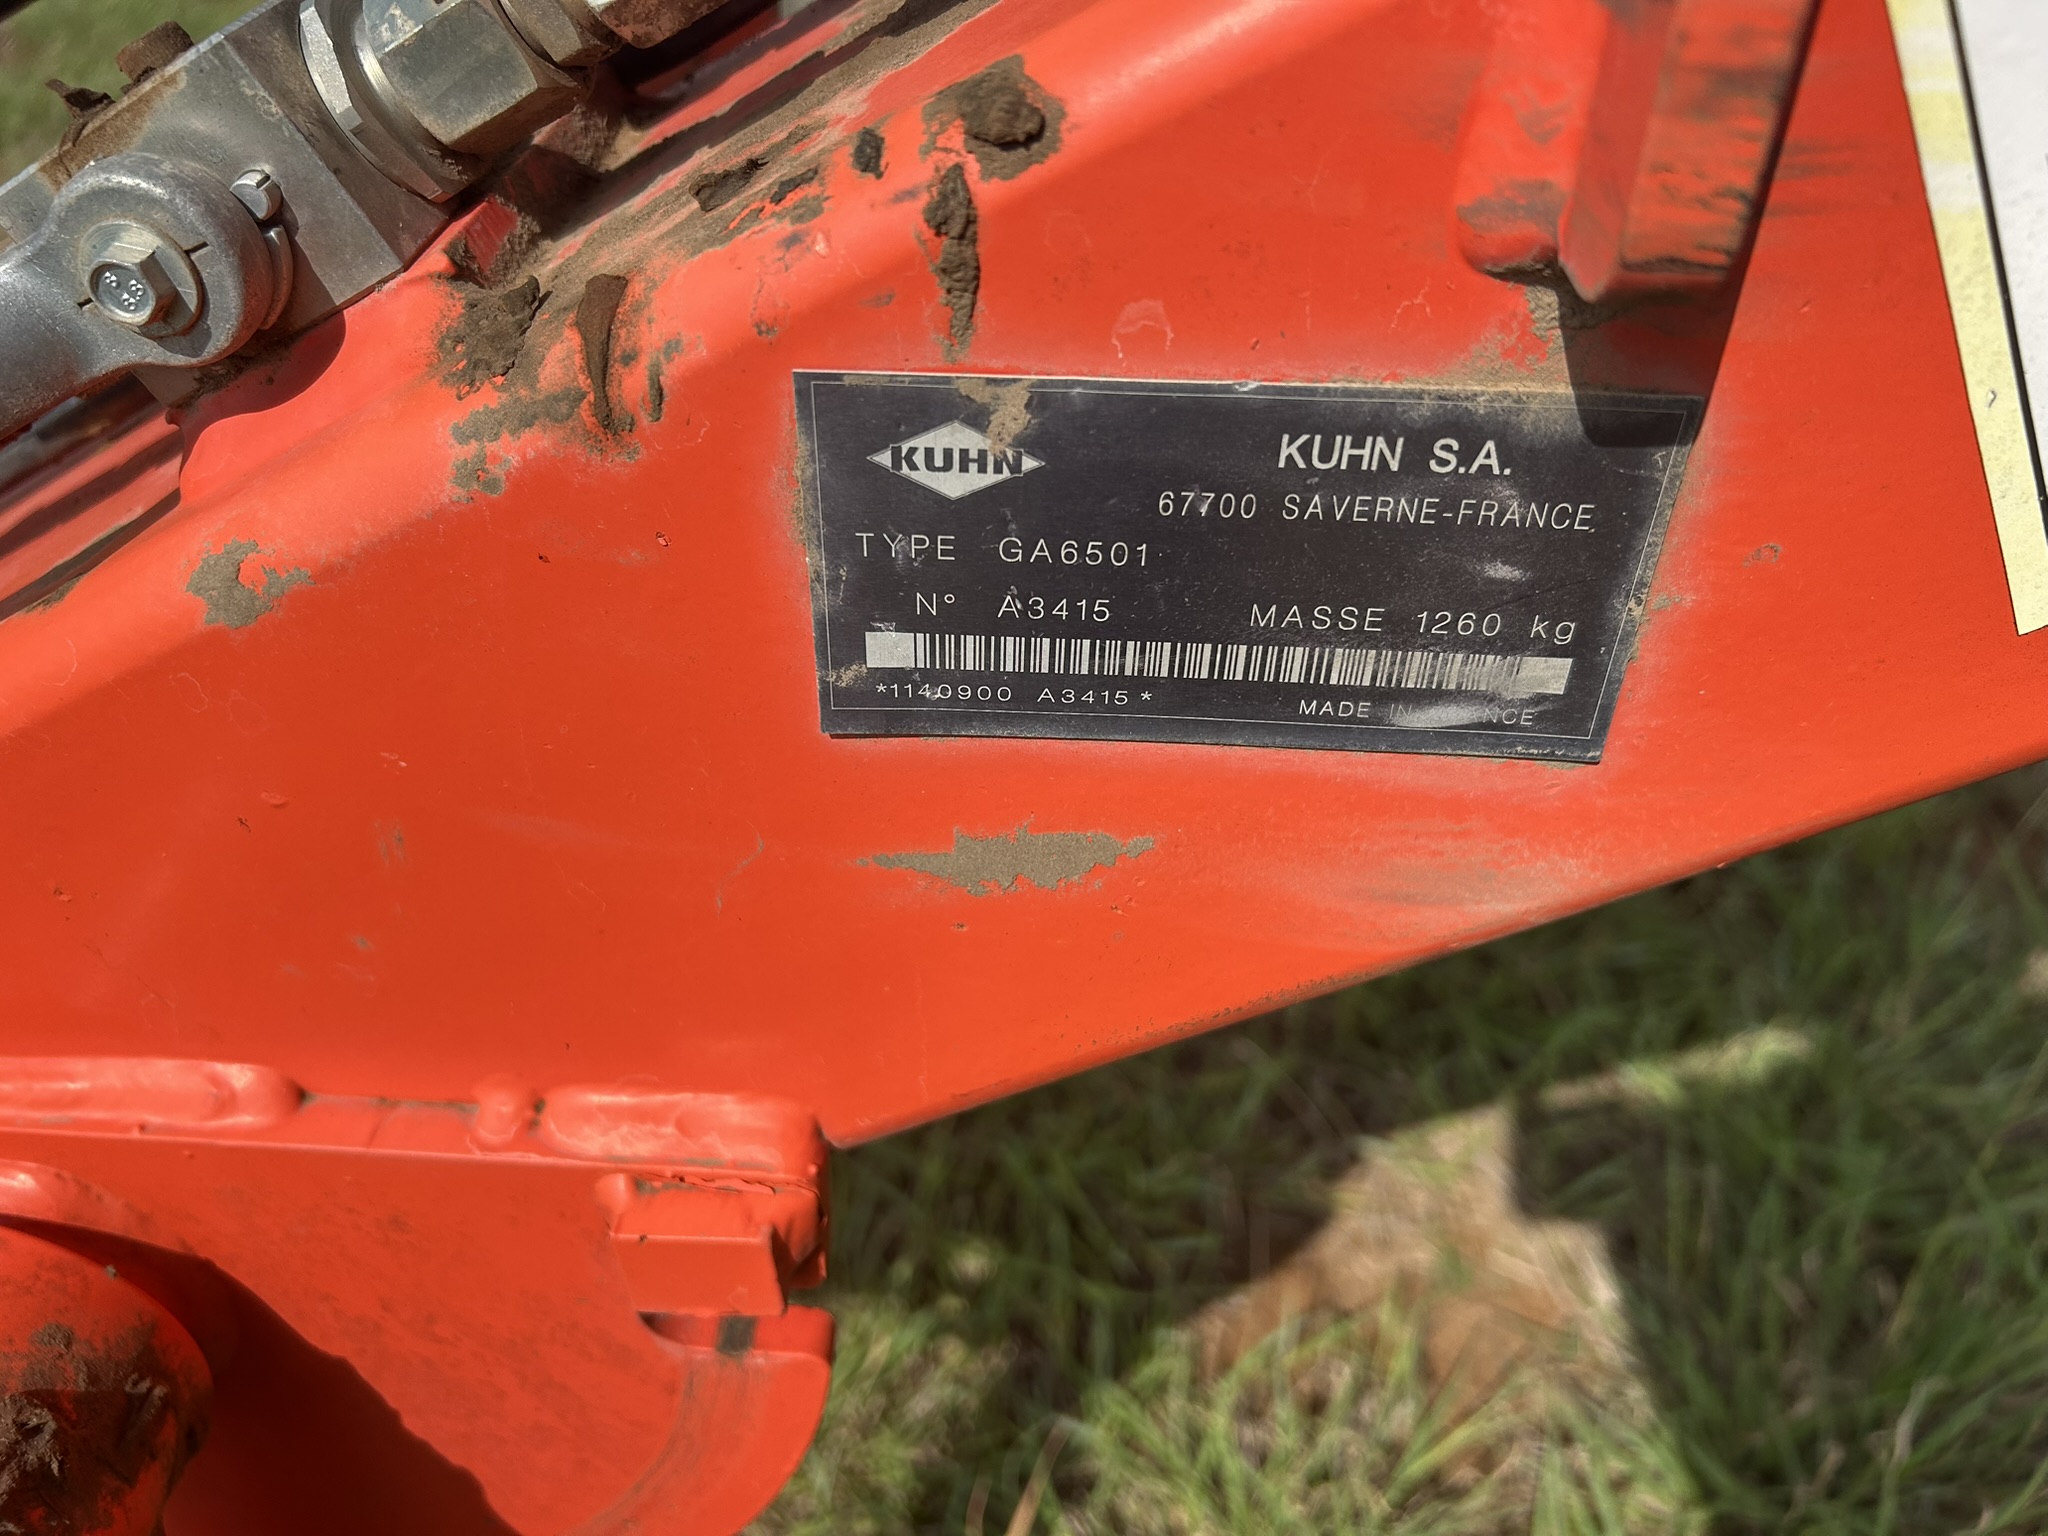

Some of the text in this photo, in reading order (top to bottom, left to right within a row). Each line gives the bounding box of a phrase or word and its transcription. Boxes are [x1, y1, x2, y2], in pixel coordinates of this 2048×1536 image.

[890, 445, 1023, 475] KUHN
[1278, 434, 1512, 475] KUHN S.A.
[1158, 490, 1595, 531] 67700 SAVERNE-FRANCE
[855, 532, 1147, 567] TYPE GA6501
[997, 595, 1110, 622] A3415
[1250, 603, 1576, 644] MASSE 1260 kg
[1298, 699, 1371, 718] MADE
